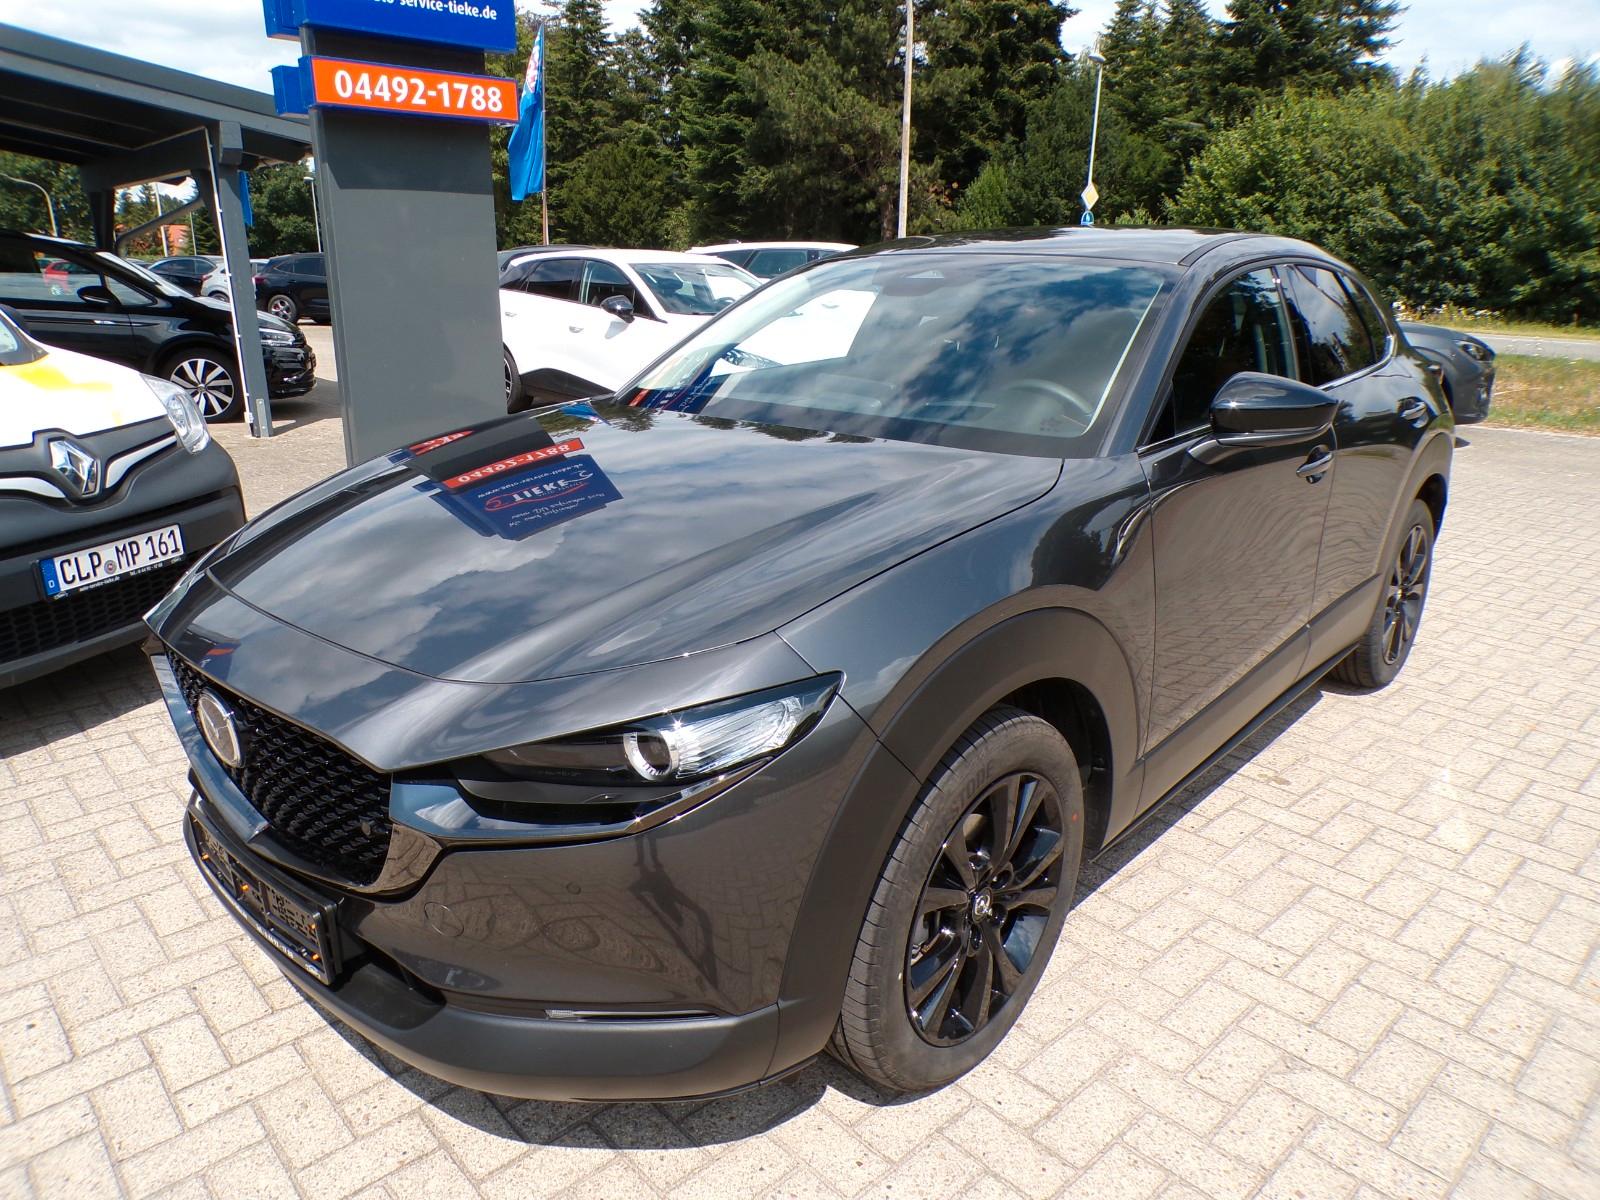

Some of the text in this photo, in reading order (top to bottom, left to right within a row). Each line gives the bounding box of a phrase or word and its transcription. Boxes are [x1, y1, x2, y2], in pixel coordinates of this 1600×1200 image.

[334, 70, 503, 112] 04492-1788
[59, 551, 103, 585] CLP
[115, 540, 141, 570] MP
[145, 529, 181, 561] 161
[48, 580, 55, 588] D
